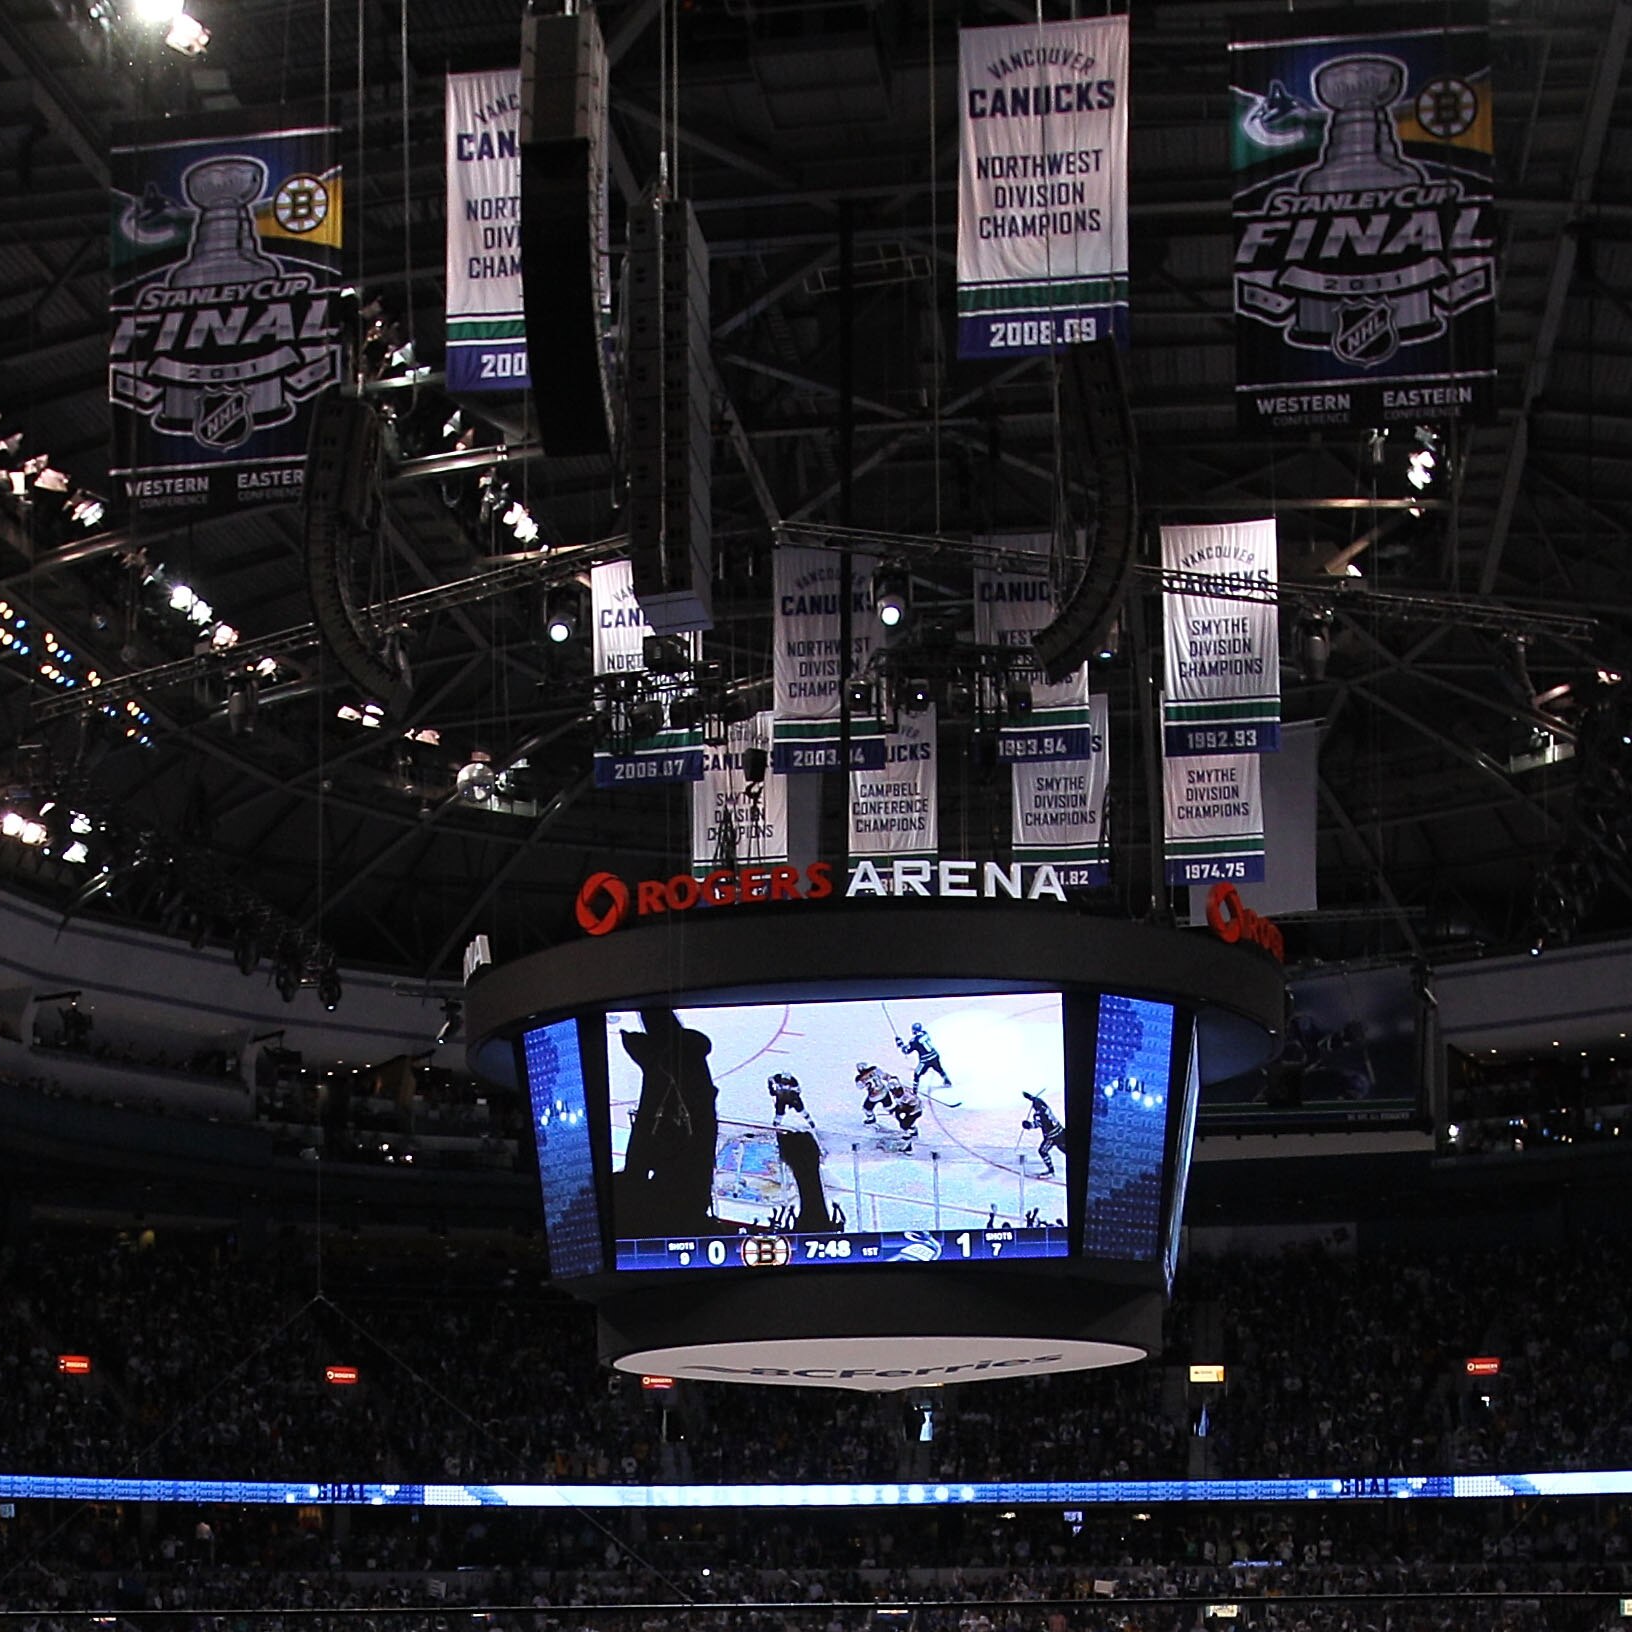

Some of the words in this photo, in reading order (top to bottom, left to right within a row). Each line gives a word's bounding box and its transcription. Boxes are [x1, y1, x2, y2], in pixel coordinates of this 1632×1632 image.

[988, 47, 1095, 80] VANCOUVER
[969, 80, 1115, 118] CANUCKS
[976, 149, 1103, 179] NORTHWEST
[994, 182, 1085, 208] DIVISION
[1269, 191, 1396, 217] STANLEY
[979, 209, 1101, 239] CHAMPIONS
[1235, 207, 1494, 264] FINAL
[1324, 273, 1402, 291] 2011
[142, 284, 253, 310] STANLEY
[109, 298, 342, 355] FINAL
[988, 317, 1098, 348] 2008.09
[1346, 308, 1388, 352] NHL
[187, 361, 258, 379] 2011
[1256, 392, 1352, 416] WESTERN
[1382, 386, 1473, 408] EASTERN
[206, 397, 244, 437] NHL
[125, 475, 210, 497] WESTERN
[236, 469, 305, 489] EASTER
[1181, 545, 1256, 568] VANCOUVER
[1191, 616, 1248, 636] SMYTHE
[1189, 637, 1252, 657] DIVISION
[1179, 657, 1263, 678] CHAMPIONS
[1186, 729, 1258, 750] 1992.93
[614, 759, 685, 780] 2006.07
[1187, 767, 1237, 785] SMYTHE
[859, 781, 921, 799] CAMPBELL
[1036, 775, 1085, 791] SMYTHE
[1185, 785, 1240, 802] DIVISION
[852, 798, 929, 816] CONFERENCE
[1033, 794, 1087, 809] DIVISION
[1177, 802, 1250, 820] CHAMPIONS
[855, 816, 926, 833] CHAMPIONS
[1025, 810, 1097, 827] CHAMPIONS
[1183, 861, 1246, 880] 1974.75
[637, 861, 835, 917] ROGERS
[844, 859, 1068, 903] ARENA
[668, 1242, 695, 1251] SHOTS
[708, 1240, 727, 1266] 0
[805, 1240, 851, 1259] 7:48
[955, 1233, 971, 1258] 1
[985, 1231, 1013, 1242] SHOTS
[991, 1242, 1002, 1257] 7
